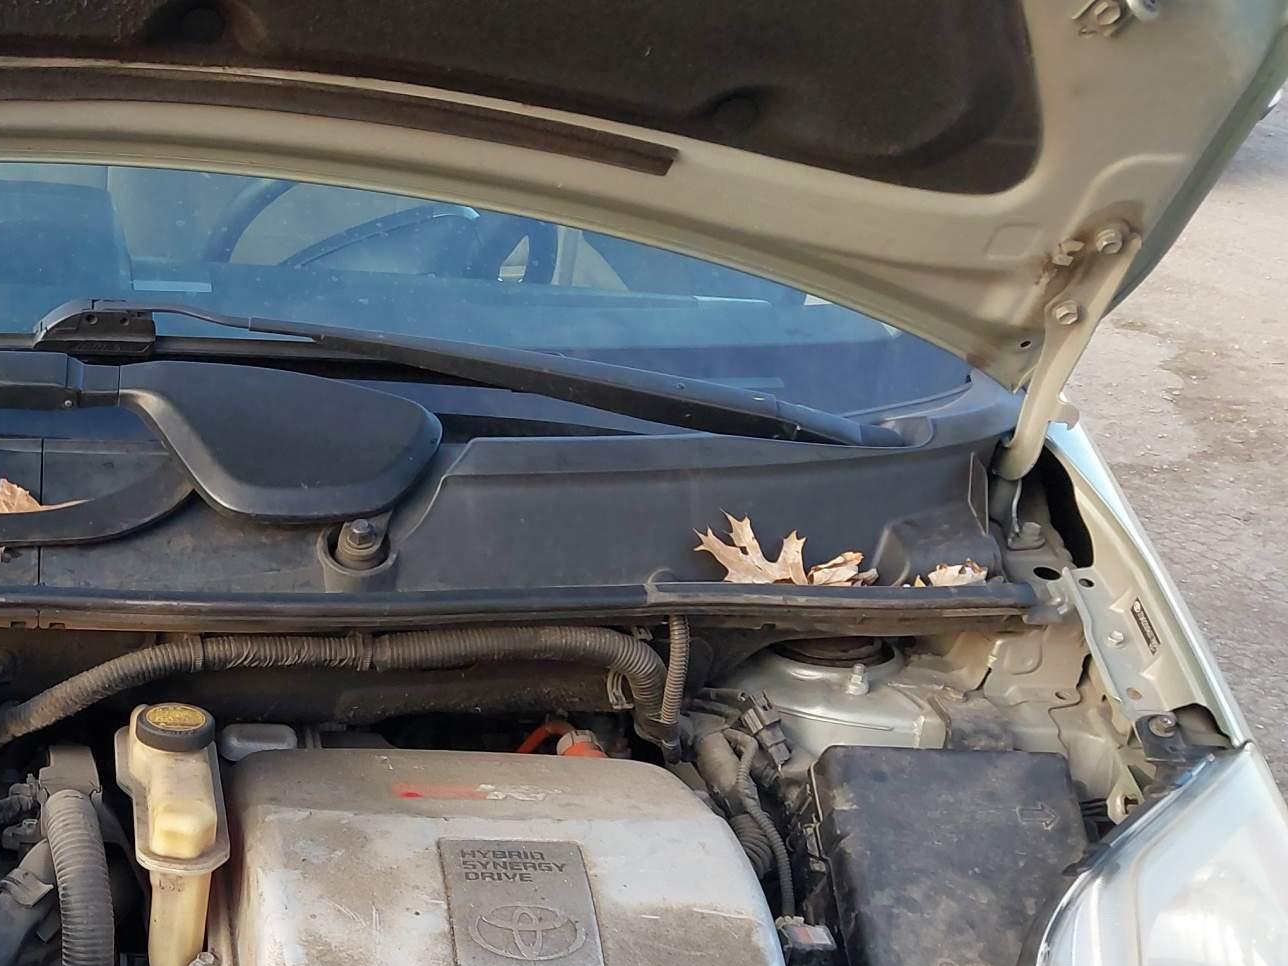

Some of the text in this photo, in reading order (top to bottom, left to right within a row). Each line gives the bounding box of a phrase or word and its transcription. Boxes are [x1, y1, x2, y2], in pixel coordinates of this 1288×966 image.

[461, 849, 545, 861] HYBRID
[463, 860, 567, 873] SYNERGY
[464, 871, 533, 882] DRIVE
